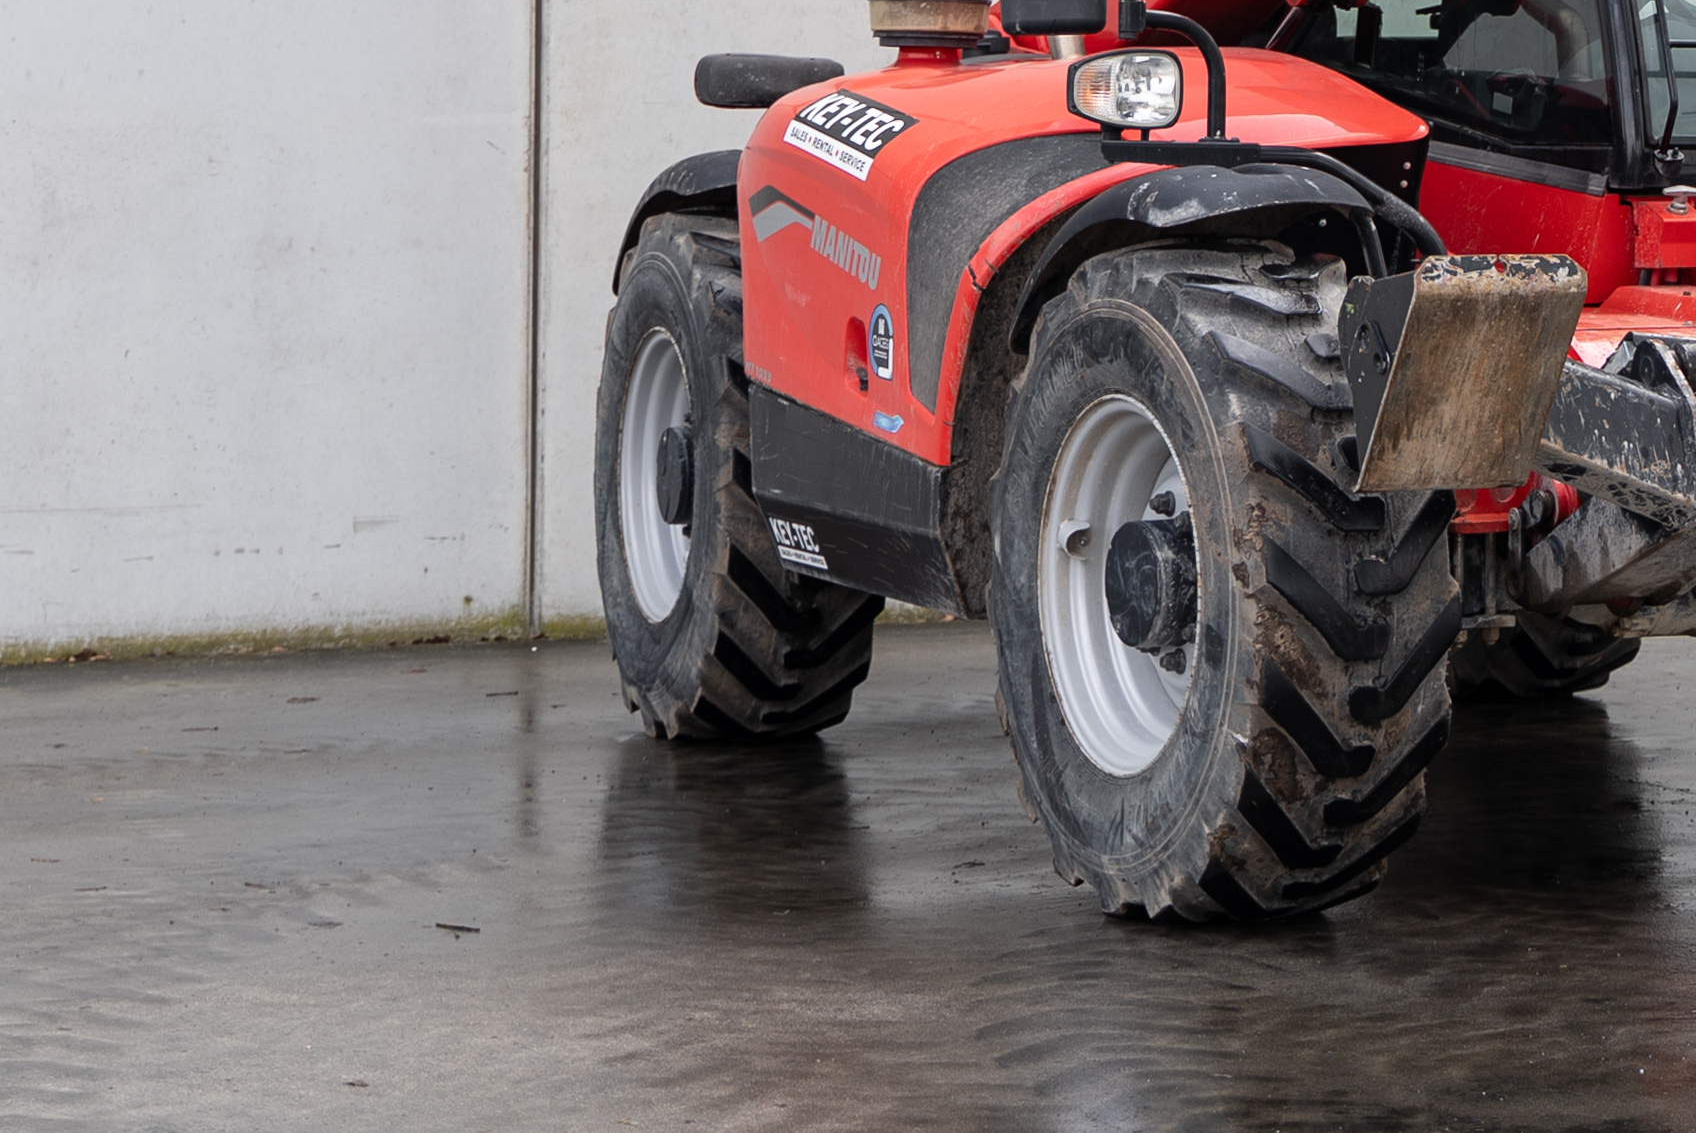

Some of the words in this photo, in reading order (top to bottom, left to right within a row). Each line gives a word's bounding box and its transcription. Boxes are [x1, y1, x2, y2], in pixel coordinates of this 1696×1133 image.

[799, 93, 905, 151] KEY-TEC
[790, 126, 808, 143] SALES
[812, 137, 834, 156] RENTAL
[839, 150, 866, 172] SERVICE
[810, 215, 882, 290] MANITOU
[769, 517, 819, 552] KEY-TEC
